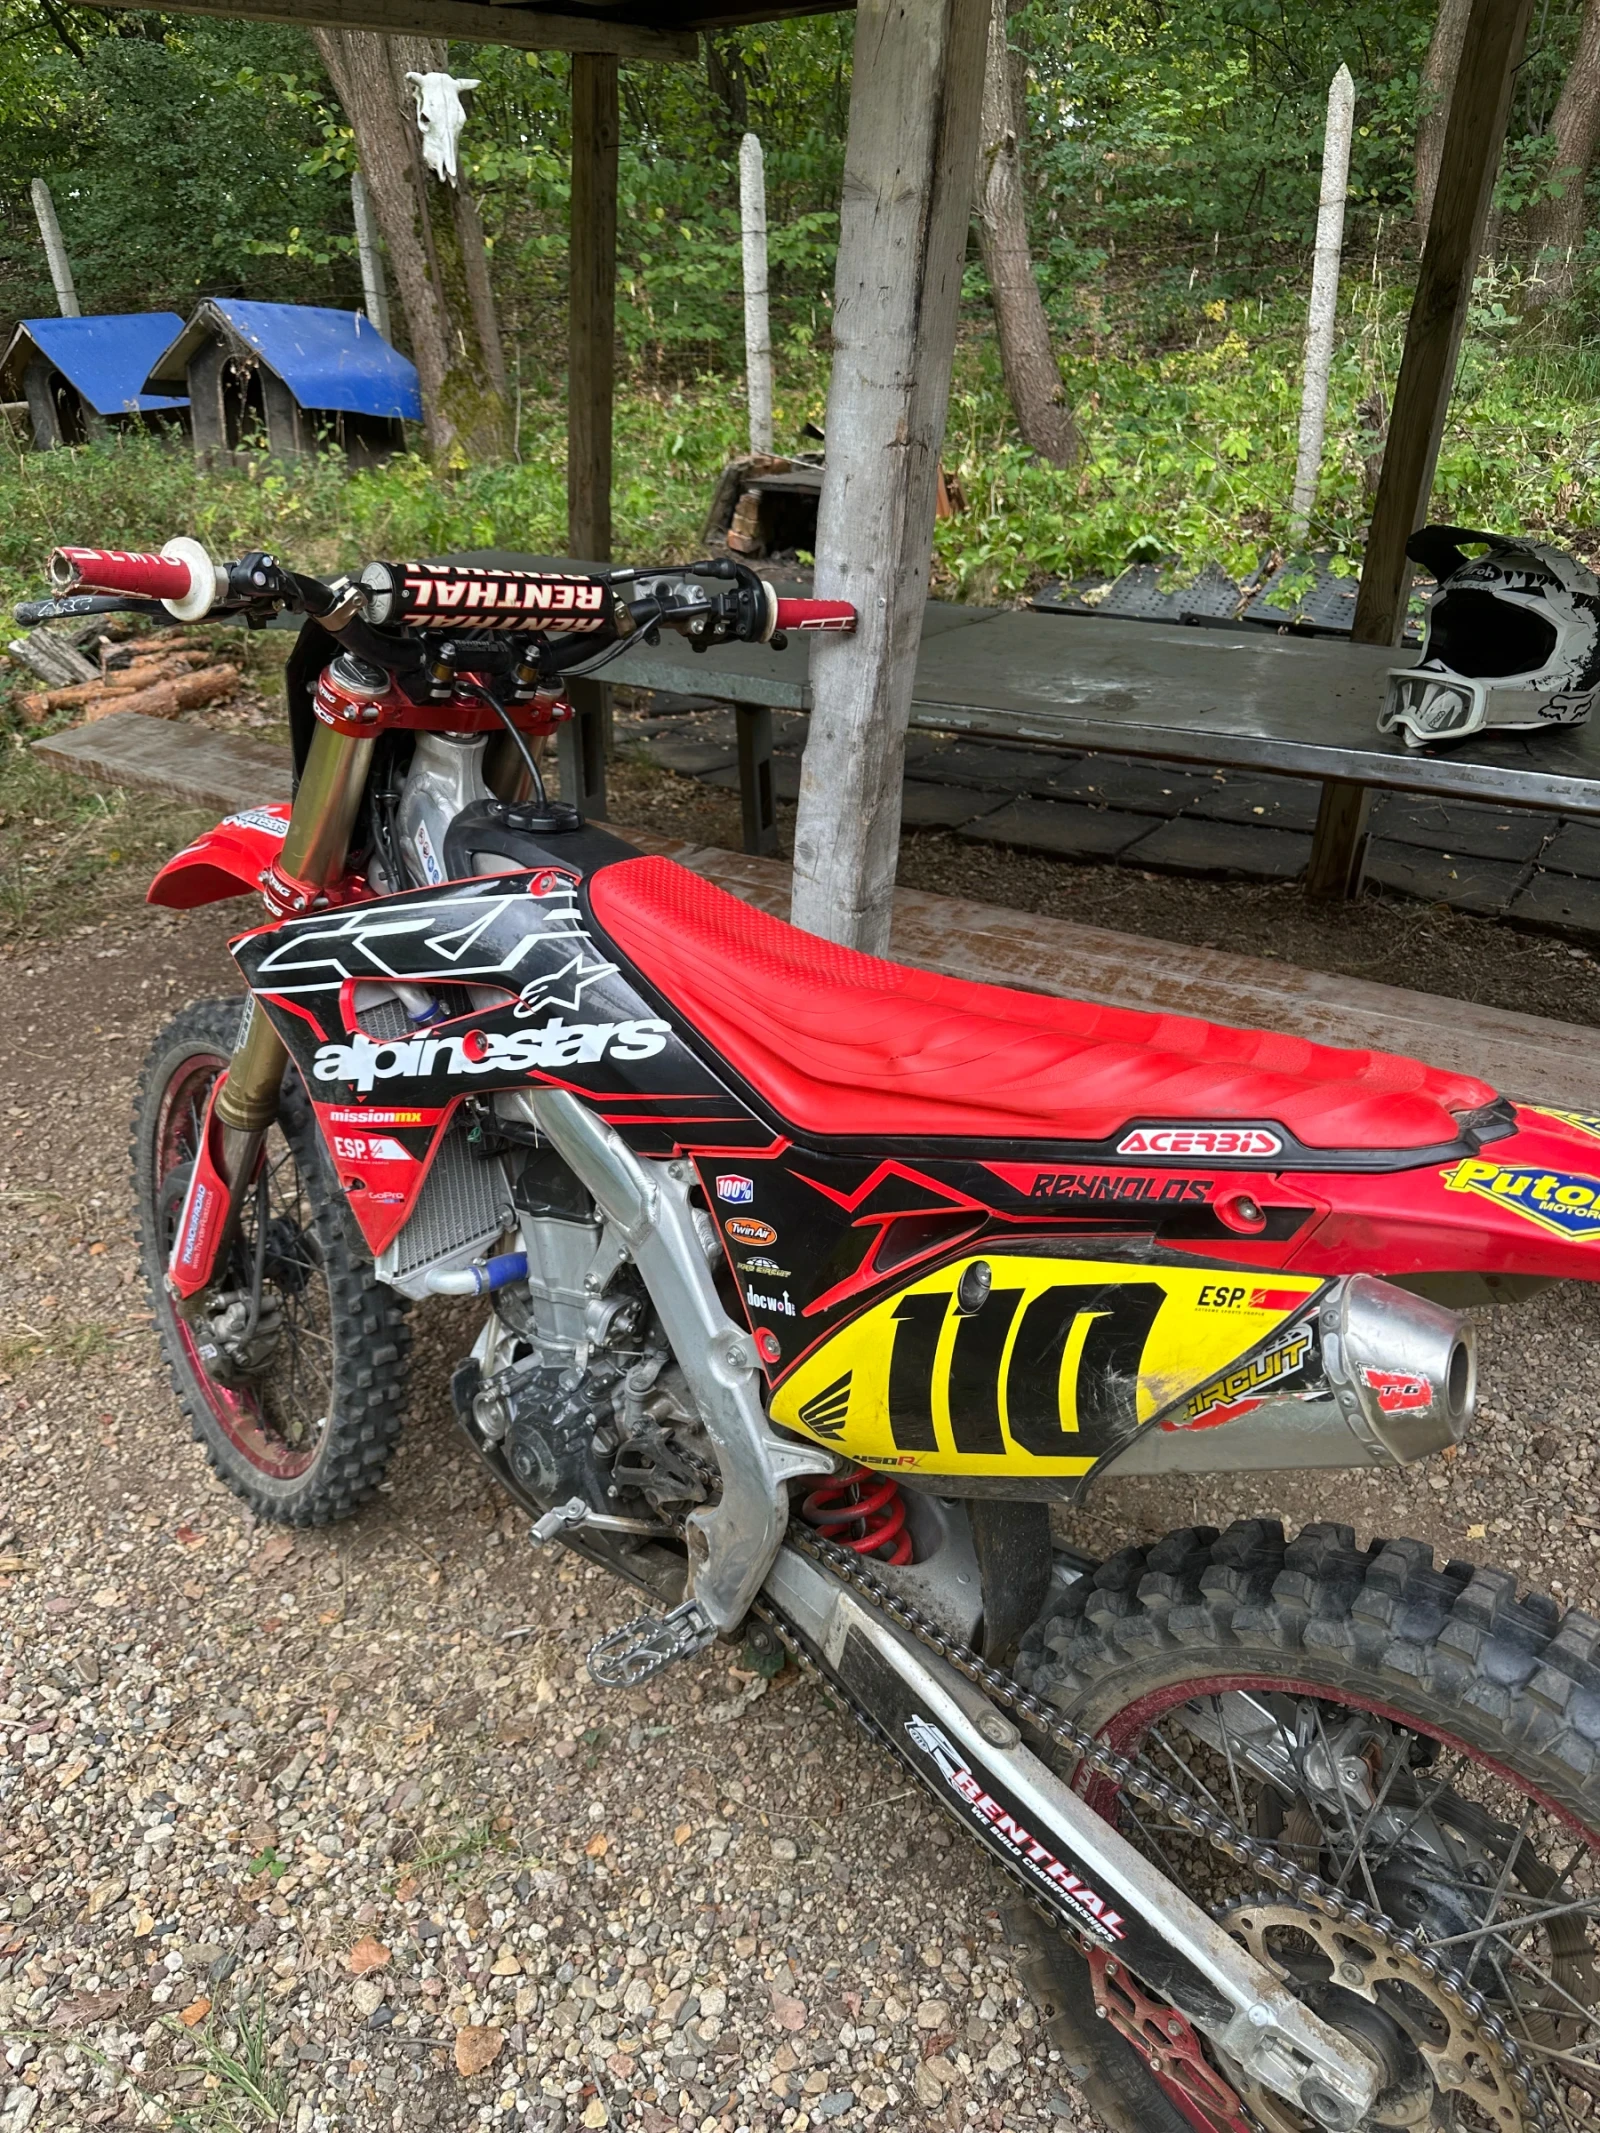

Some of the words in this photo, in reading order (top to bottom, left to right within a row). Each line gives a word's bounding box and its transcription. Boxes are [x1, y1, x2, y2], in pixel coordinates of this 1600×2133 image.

[404, 579, 603, 610] RENTHAL
[38, 598, 93, 616] ARC
[313, 1017, 672, 1092] alpinestars
[330, 1108, 422, 1123] missionmx
[1119, 1131, 1276, 1153] ACERBIS
[368, 1191, 404, 1199] GoPro
[719, 1179, 752, 1200] 100%
[1030, 1173, 1215, 1203] REYNOLDS
[732, 1222, 755, 1237] Twin
[754, 1227, 771, 1239] Air
[889, 1281, 1168, 1457] 110
[1381, 1384, 1419, 1396] T-6
[951, 1767, 1128, 1941] RENTHAL
[970, 1805, 991, 1826] WE
[988, 1826, 1023, 1856] BUILD
[1021, 1857, 1117, 1943] CHAMPIONSHIPS
